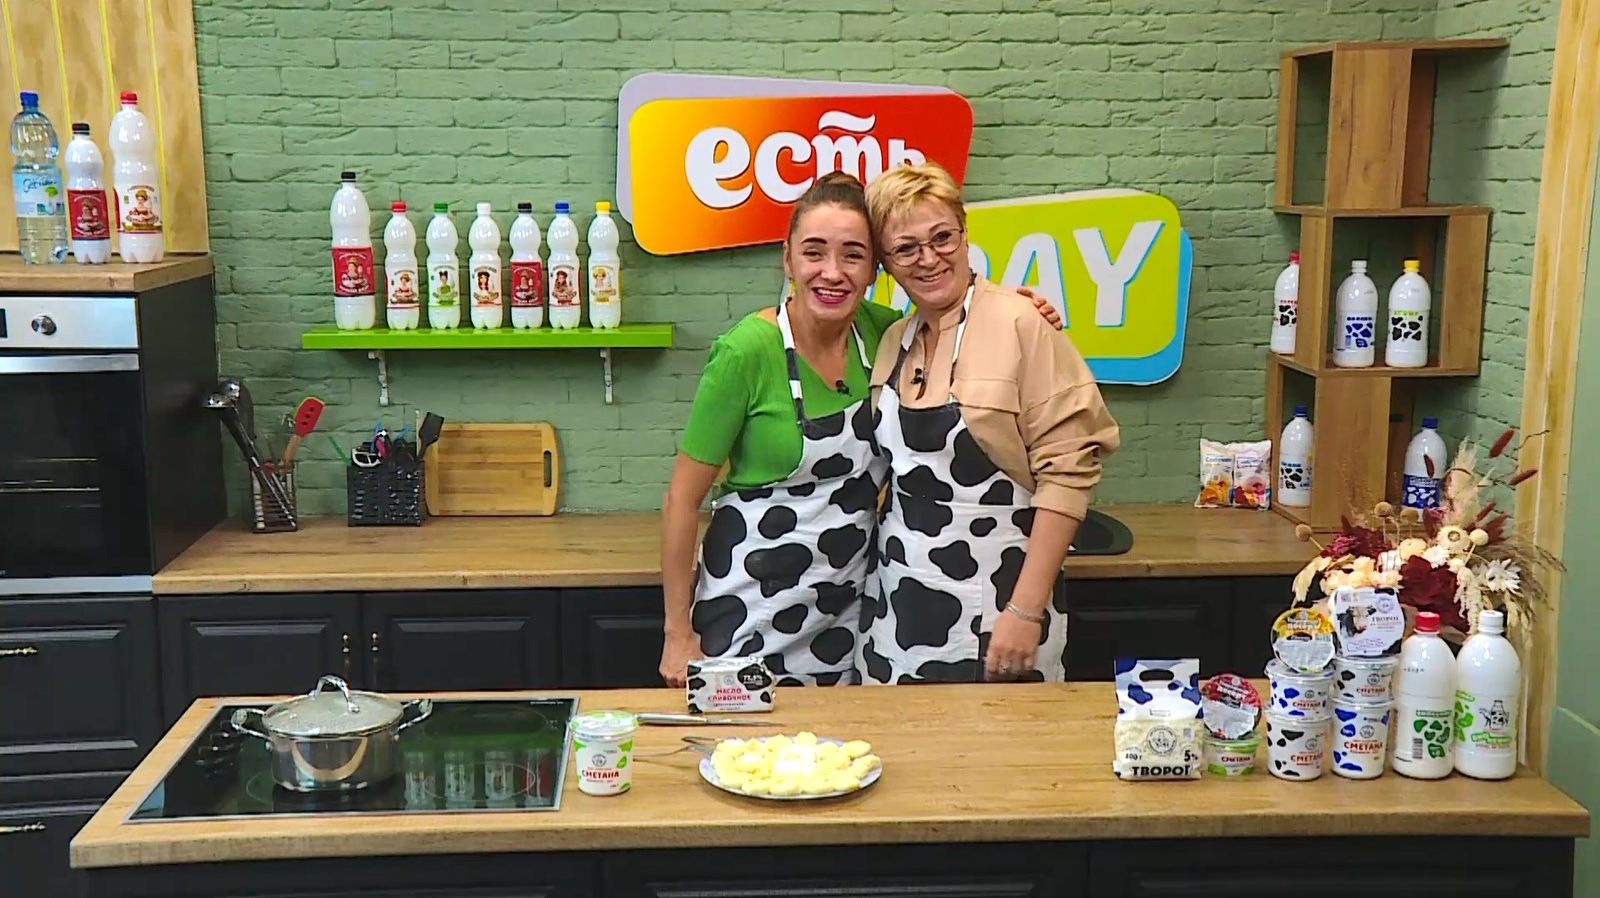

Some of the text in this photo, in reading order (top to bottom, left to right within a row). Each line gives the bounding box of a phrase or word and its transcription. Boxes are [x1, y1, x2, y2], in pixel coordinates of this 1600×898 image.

[1184, 749, 1198, 762] 5%
[581, 769, 620, 779] СМЕТАНА
[1132, 764, 1190, 776] ТВОРОГ
